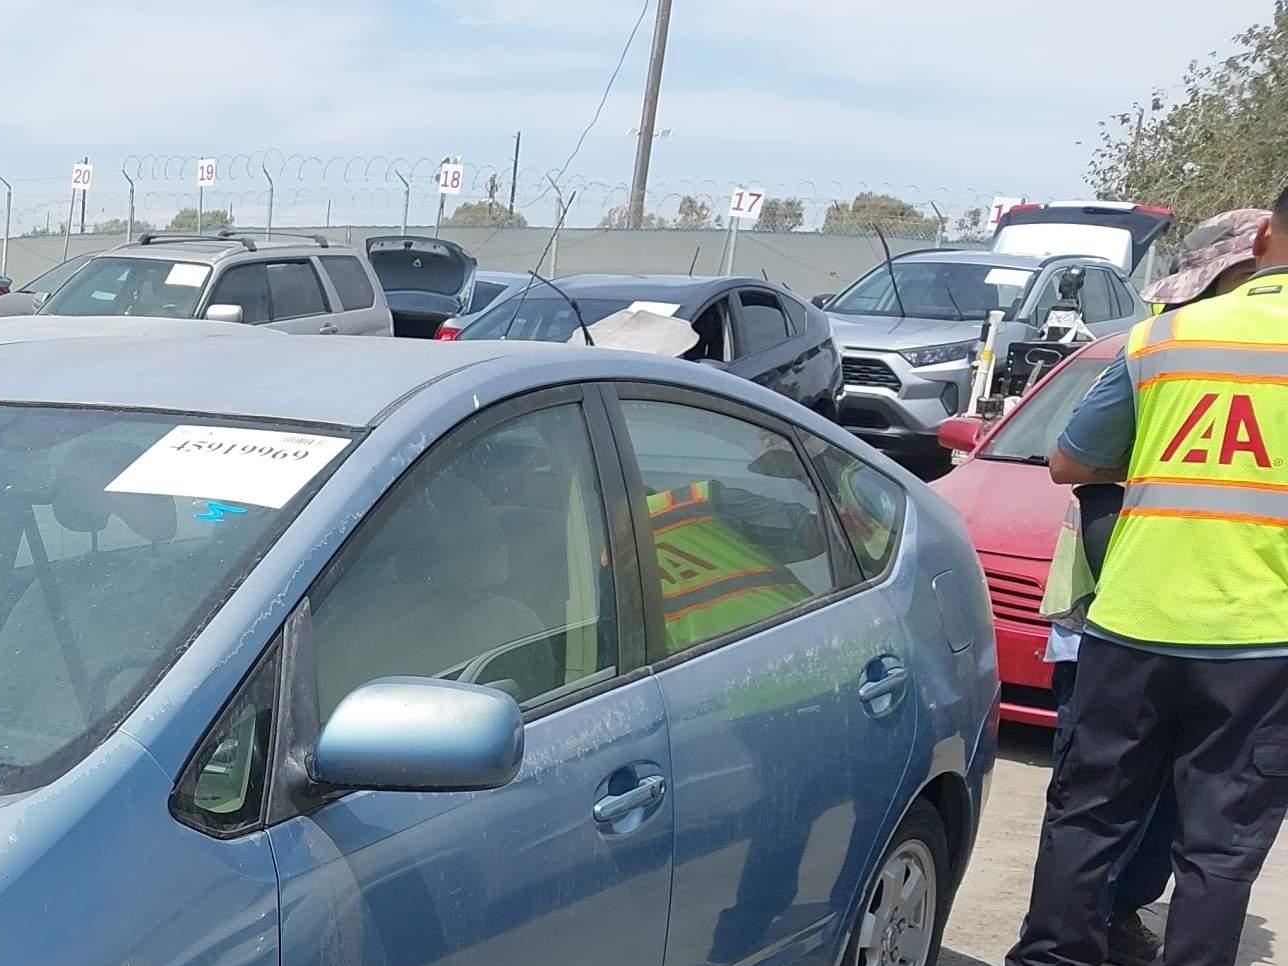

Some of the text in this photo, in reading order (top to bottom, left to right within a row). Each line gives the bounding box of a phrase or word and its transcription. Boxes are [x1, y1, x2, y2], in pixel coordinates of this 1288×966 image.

[73, 169, 91, 185] 20
[199, 164, 214, 181] 19
[441, 170, 460, 188] 18
[732, 192, 762, 212] 17
[170, 439, 310, 461] 45919969
